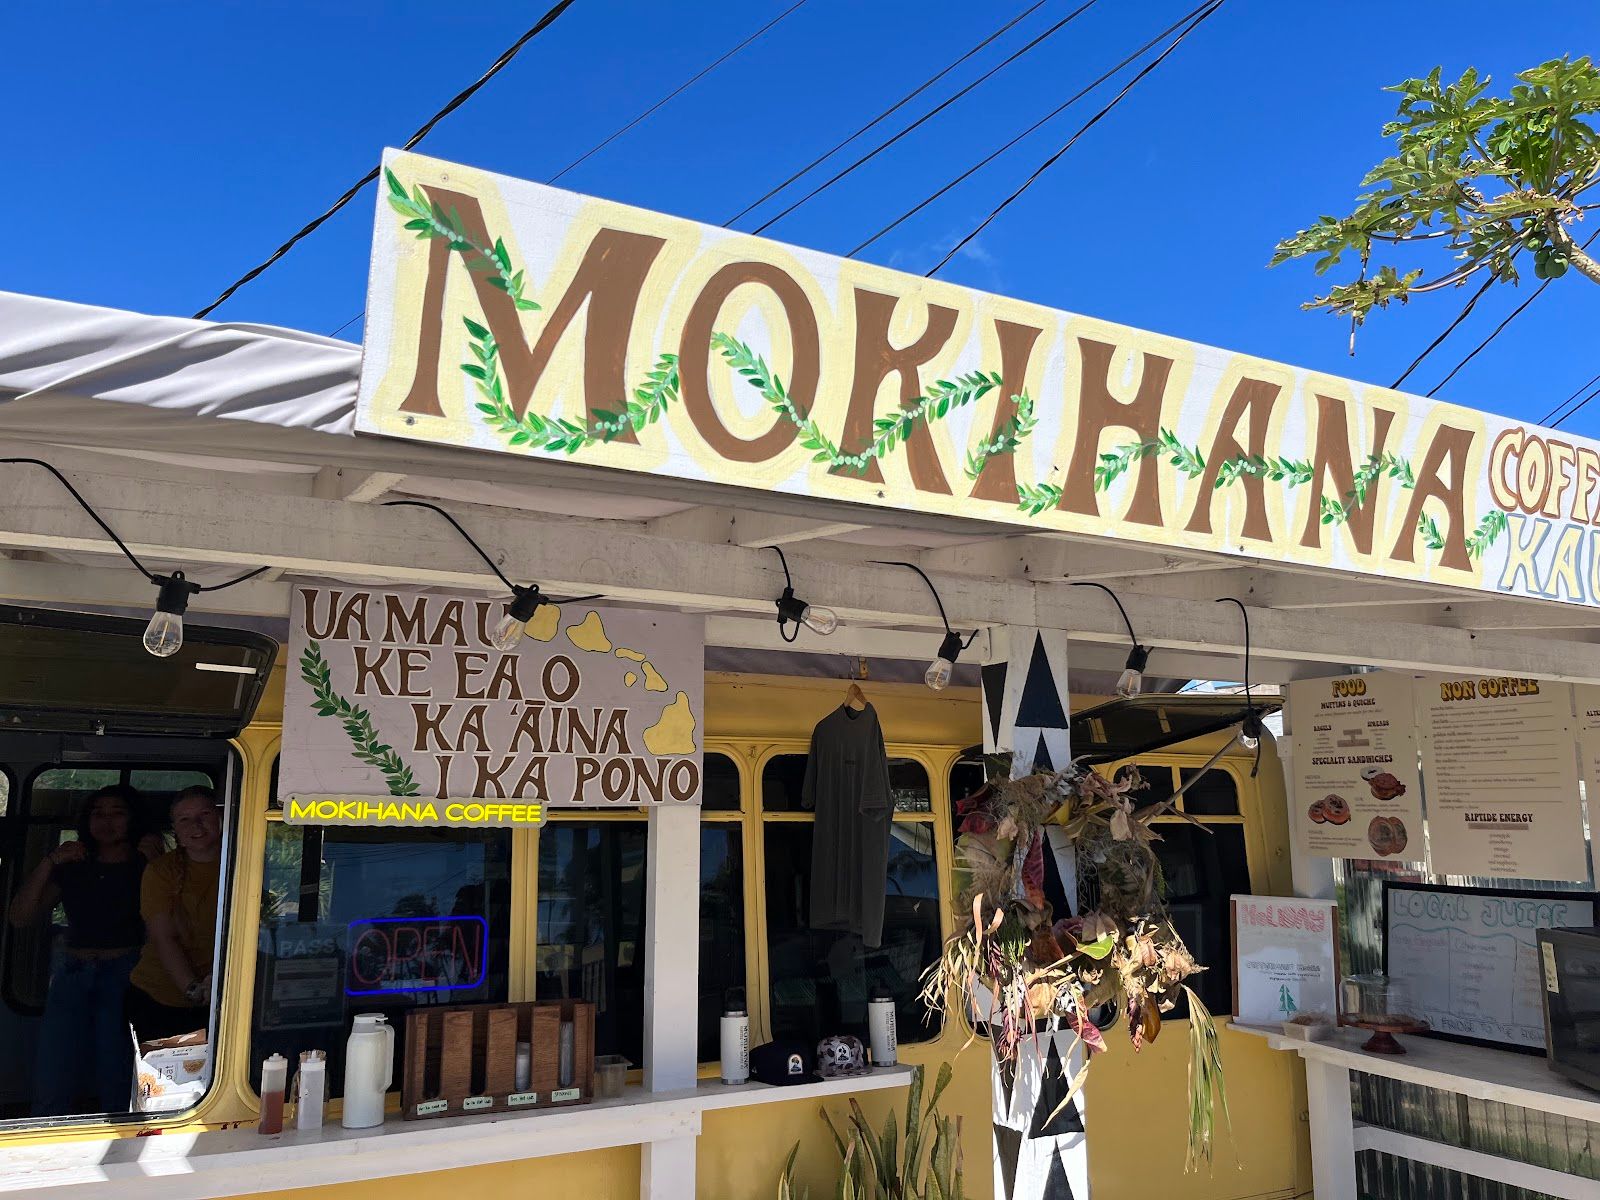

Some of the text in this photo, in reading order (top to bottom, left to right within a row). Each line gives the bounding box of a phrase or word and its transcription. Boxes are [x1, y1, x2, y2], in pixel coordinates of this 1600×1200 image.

[399, 183, 1474, 573] MOKIHANA
[1488, 427, 1600, 526] COFF
[299, 589, 512, 648] UA MAU
[353, 646, 580, 703] KE EA O
[1331, 679, 1367, 698] FOOD
[1440, 677, 1540, 701] NON COFFEE
[1353, 697, 1376, 708] QUICHE
[411, 702, 491, 752] KA
[435, 754, 700, 803] I KA PONO
[1312, 754, 1393, 766] SPECIALTY SANDWICHES
[290, 800, 542, 822] MOKIHANA COFFEE
[1464, 813, 1533, 822] RIPTIDE ENERGY
[1393, 892, 1470, 922] LOCAL
[352, 924, 481, 985] OPEN
